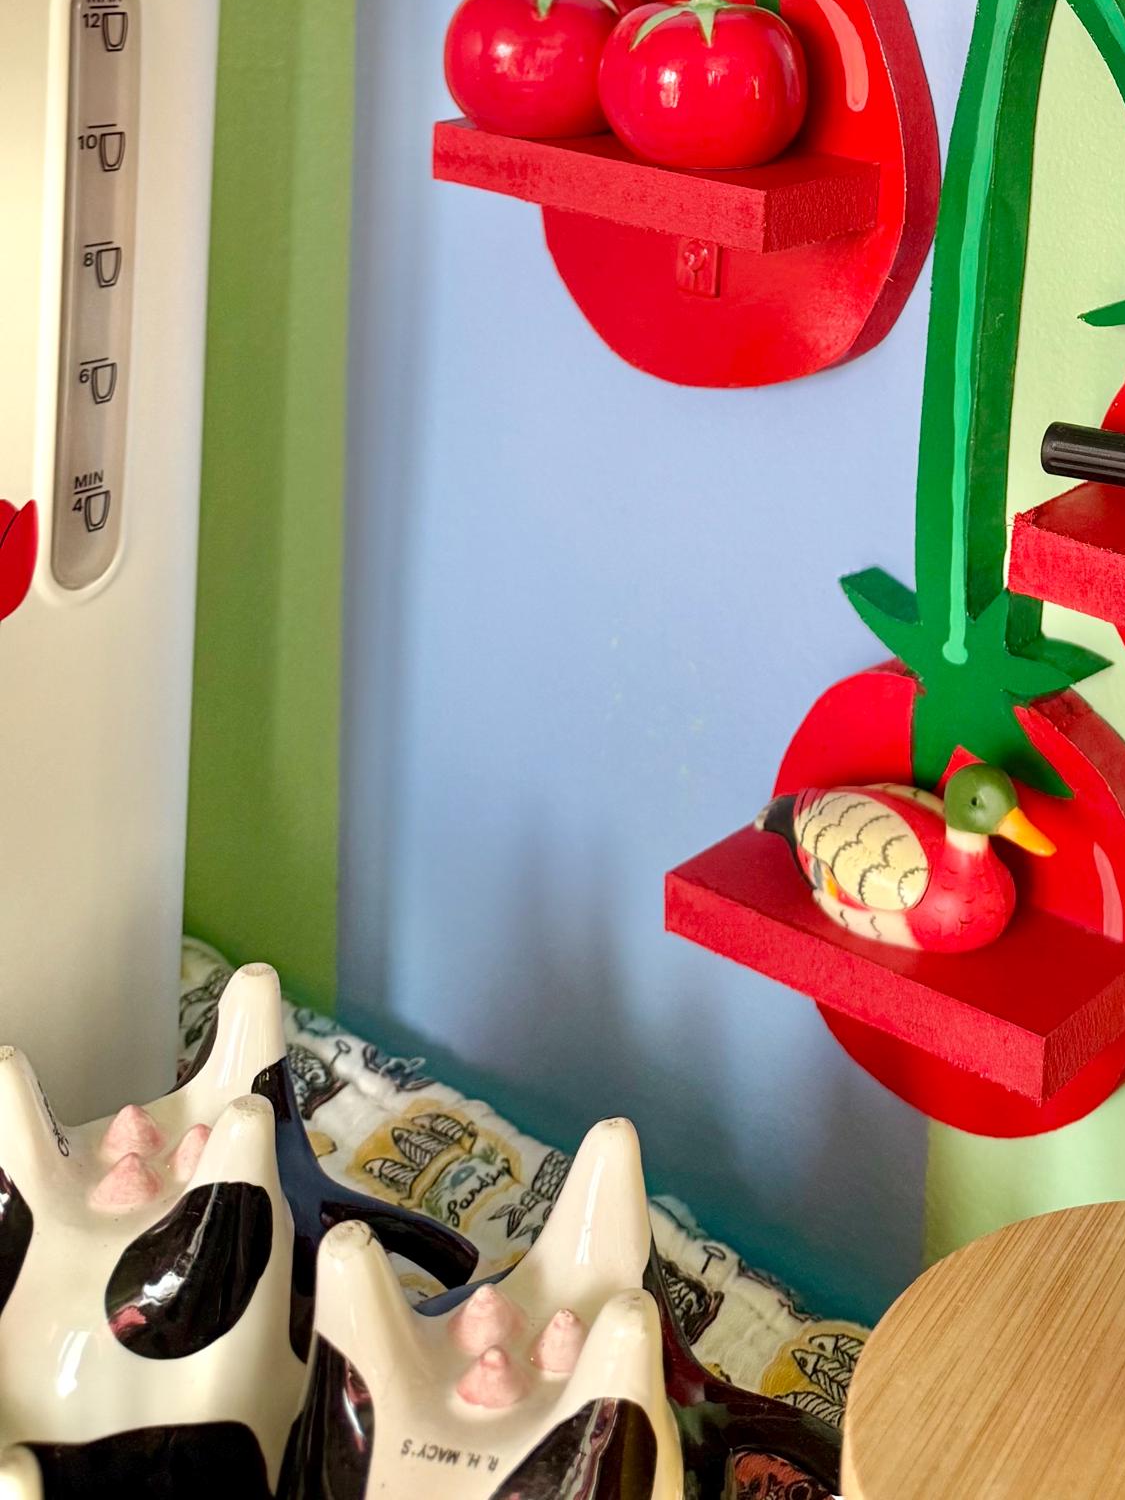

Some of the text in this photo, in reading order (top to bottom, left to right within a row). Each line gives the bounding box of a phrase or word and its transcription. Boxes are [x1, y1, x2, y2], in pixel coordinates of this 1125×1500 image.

[82, 13, 100, 28] 12
[78, 134, 98, 149] 10
[83, 252, 94, 267] 8
[79, 368, 90, 383] 6
[74, 469, 104, 489] MIN
[72, 498, 83, 512] 4
[401, 1438, 460, 1465] MACY'S
